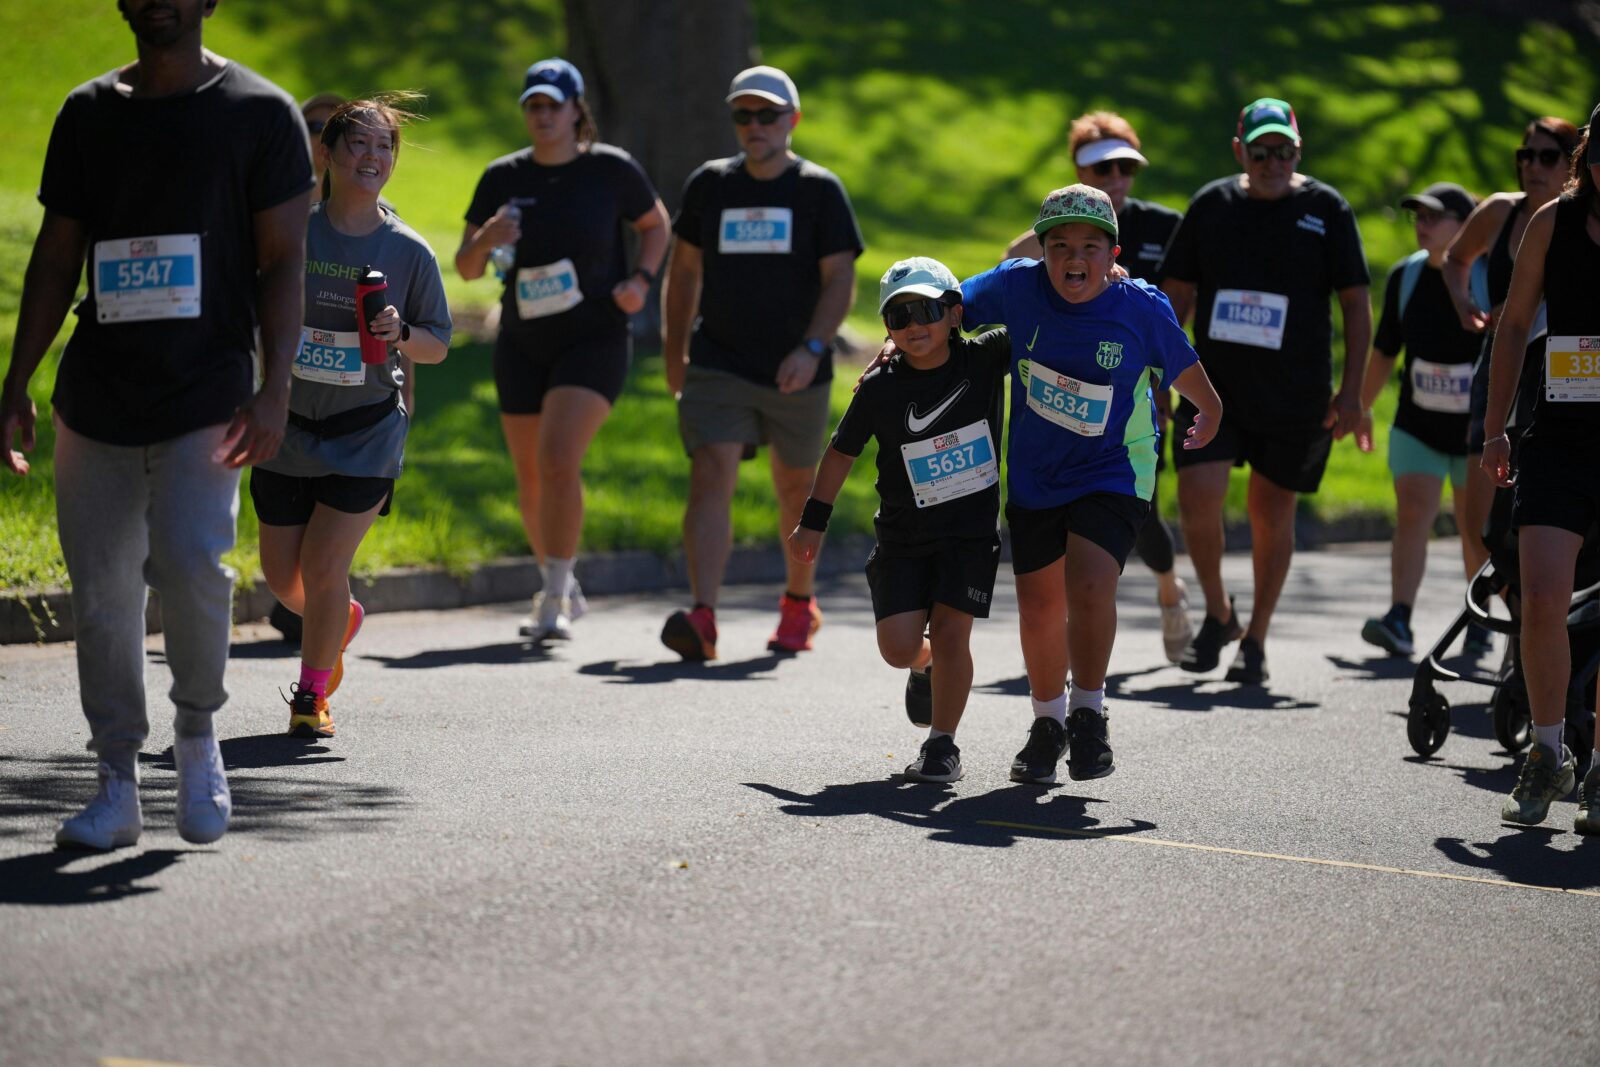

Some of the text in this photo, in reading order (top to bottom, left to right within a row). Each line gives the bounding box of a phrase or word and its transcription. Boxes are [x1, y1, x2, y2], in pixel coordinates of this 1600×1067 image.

[118, 259, 173, 288] 5547
[304, 261, 362, 281] INISHE
[1228, 304, 1272, 325] 11489
[301, 345, 346, 369] 5652
[1042, 386, 1089, 419] 5634
[927, 445, 974, 477] 5637
